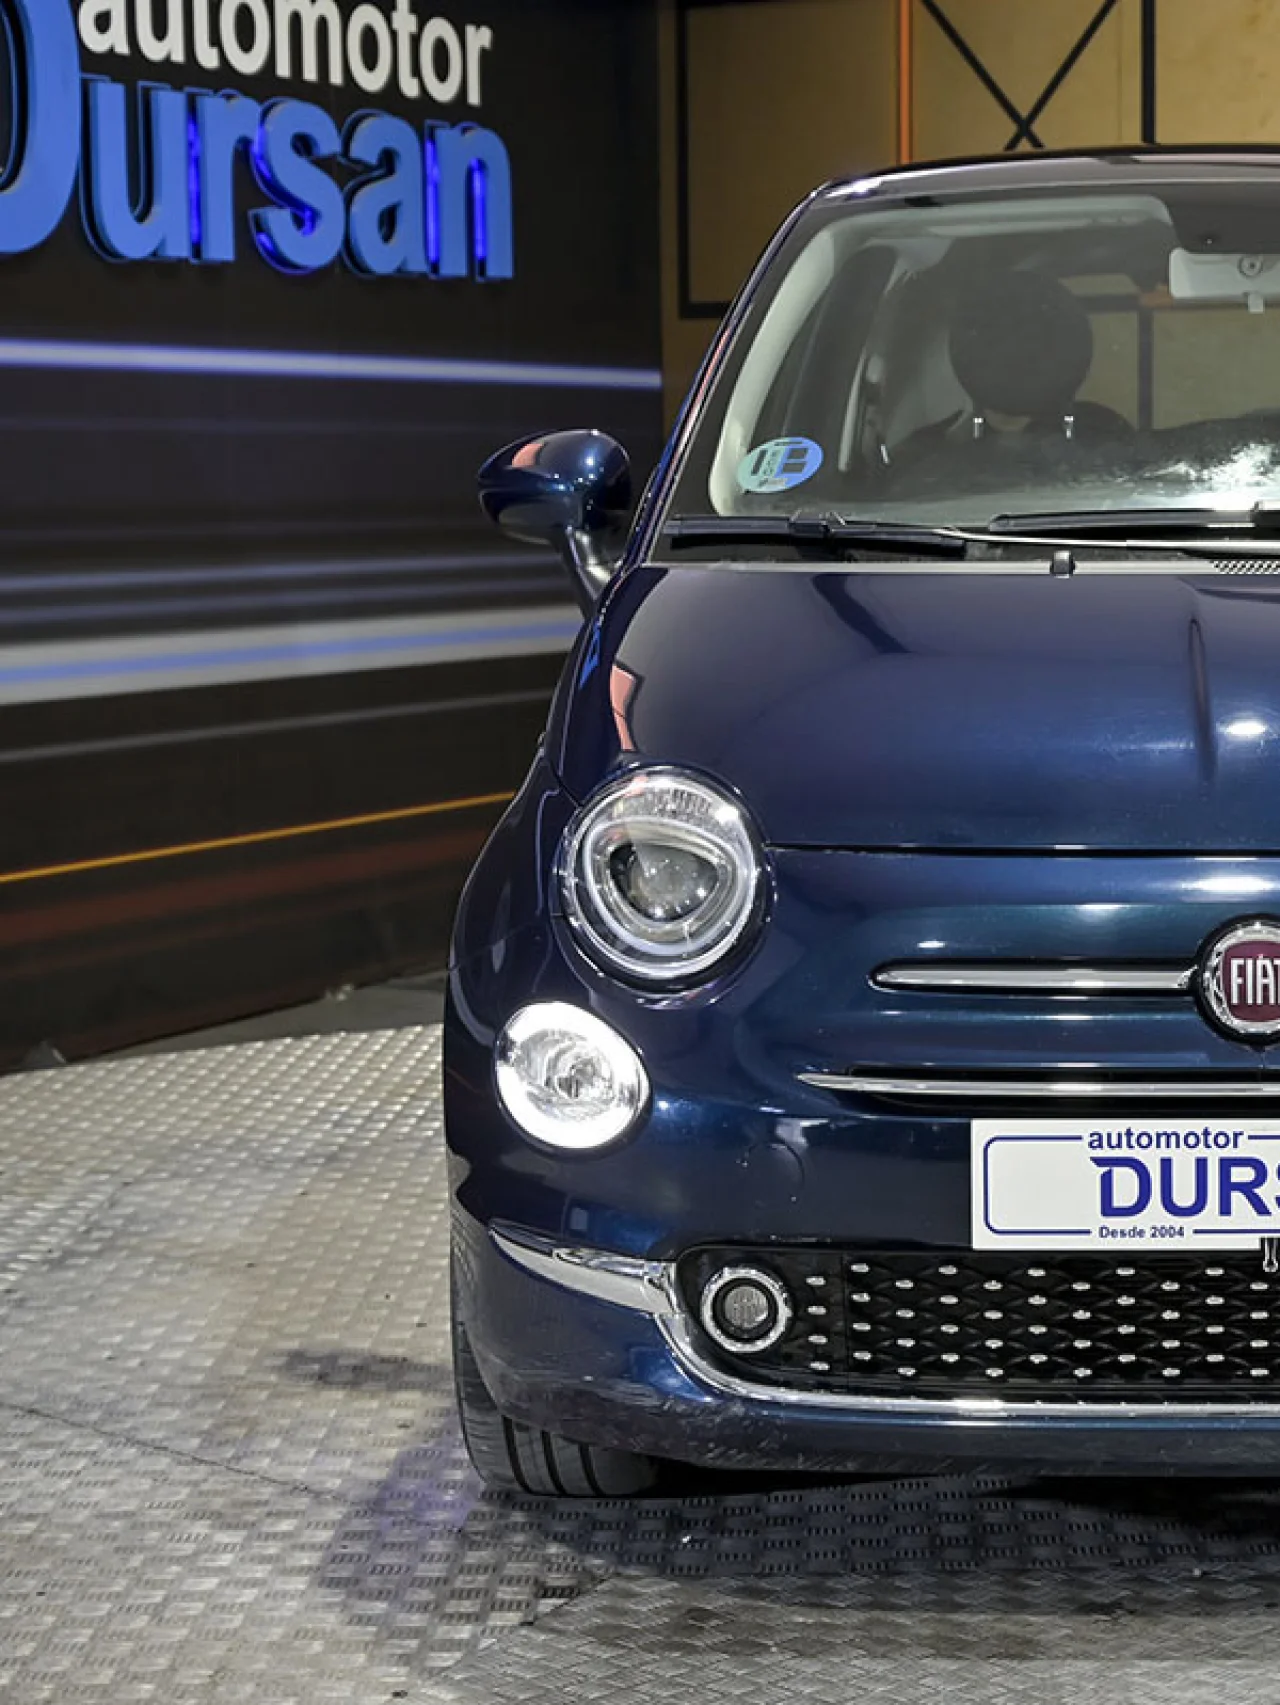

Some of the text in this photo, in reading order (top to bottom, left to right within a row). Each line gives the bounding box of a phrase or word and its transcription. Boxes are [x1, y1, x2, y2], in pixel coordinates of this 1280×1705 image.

[79, 0, 493, 105] automotor
[1088, 1127, 1244, 1149] automotor
[1099, 1225, 1185, 1238] Desde 2004
